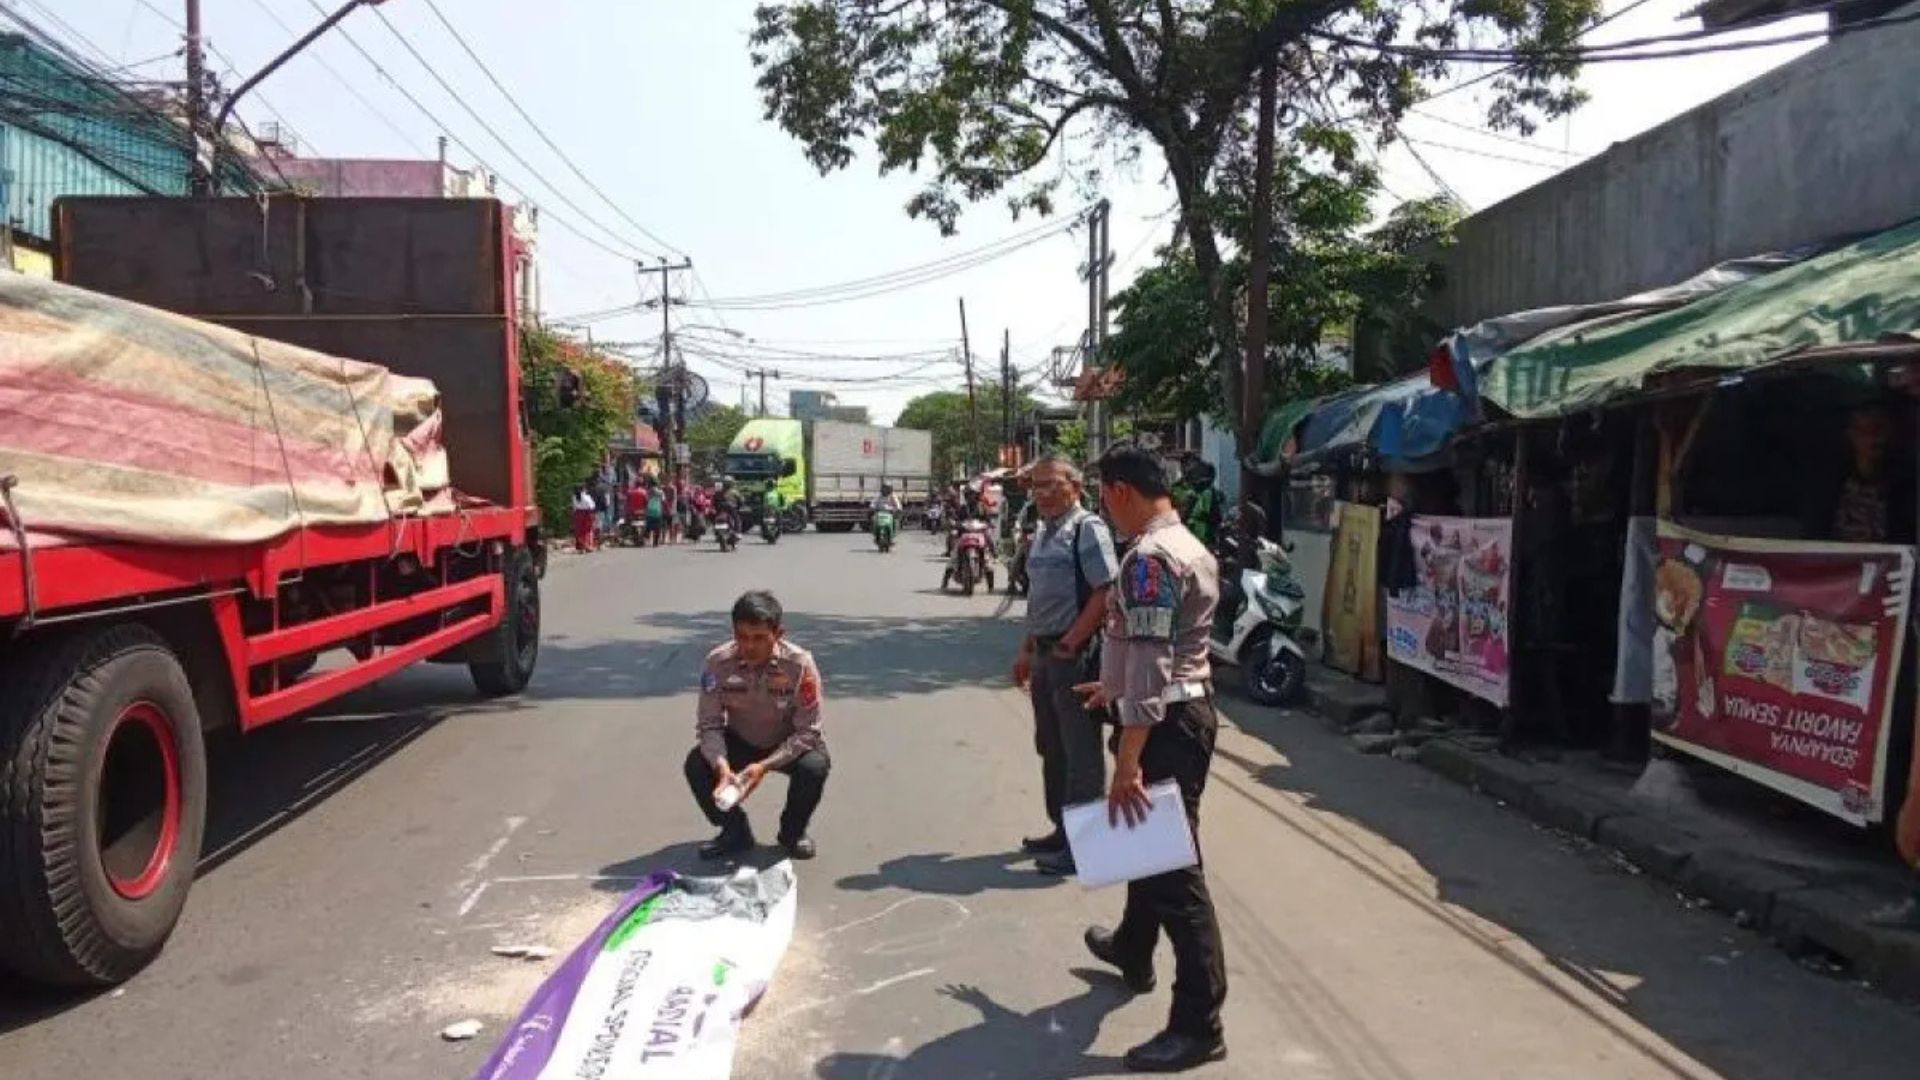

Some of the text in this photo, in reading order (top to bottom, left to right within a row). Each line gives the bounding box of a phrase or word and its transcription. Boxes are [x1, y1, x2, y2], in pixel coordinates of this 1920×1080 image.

[1724, 694, 1863, 744] FAVORIT SEMUA
[1770, 731, 1859, 770] SEDAAPNYA
